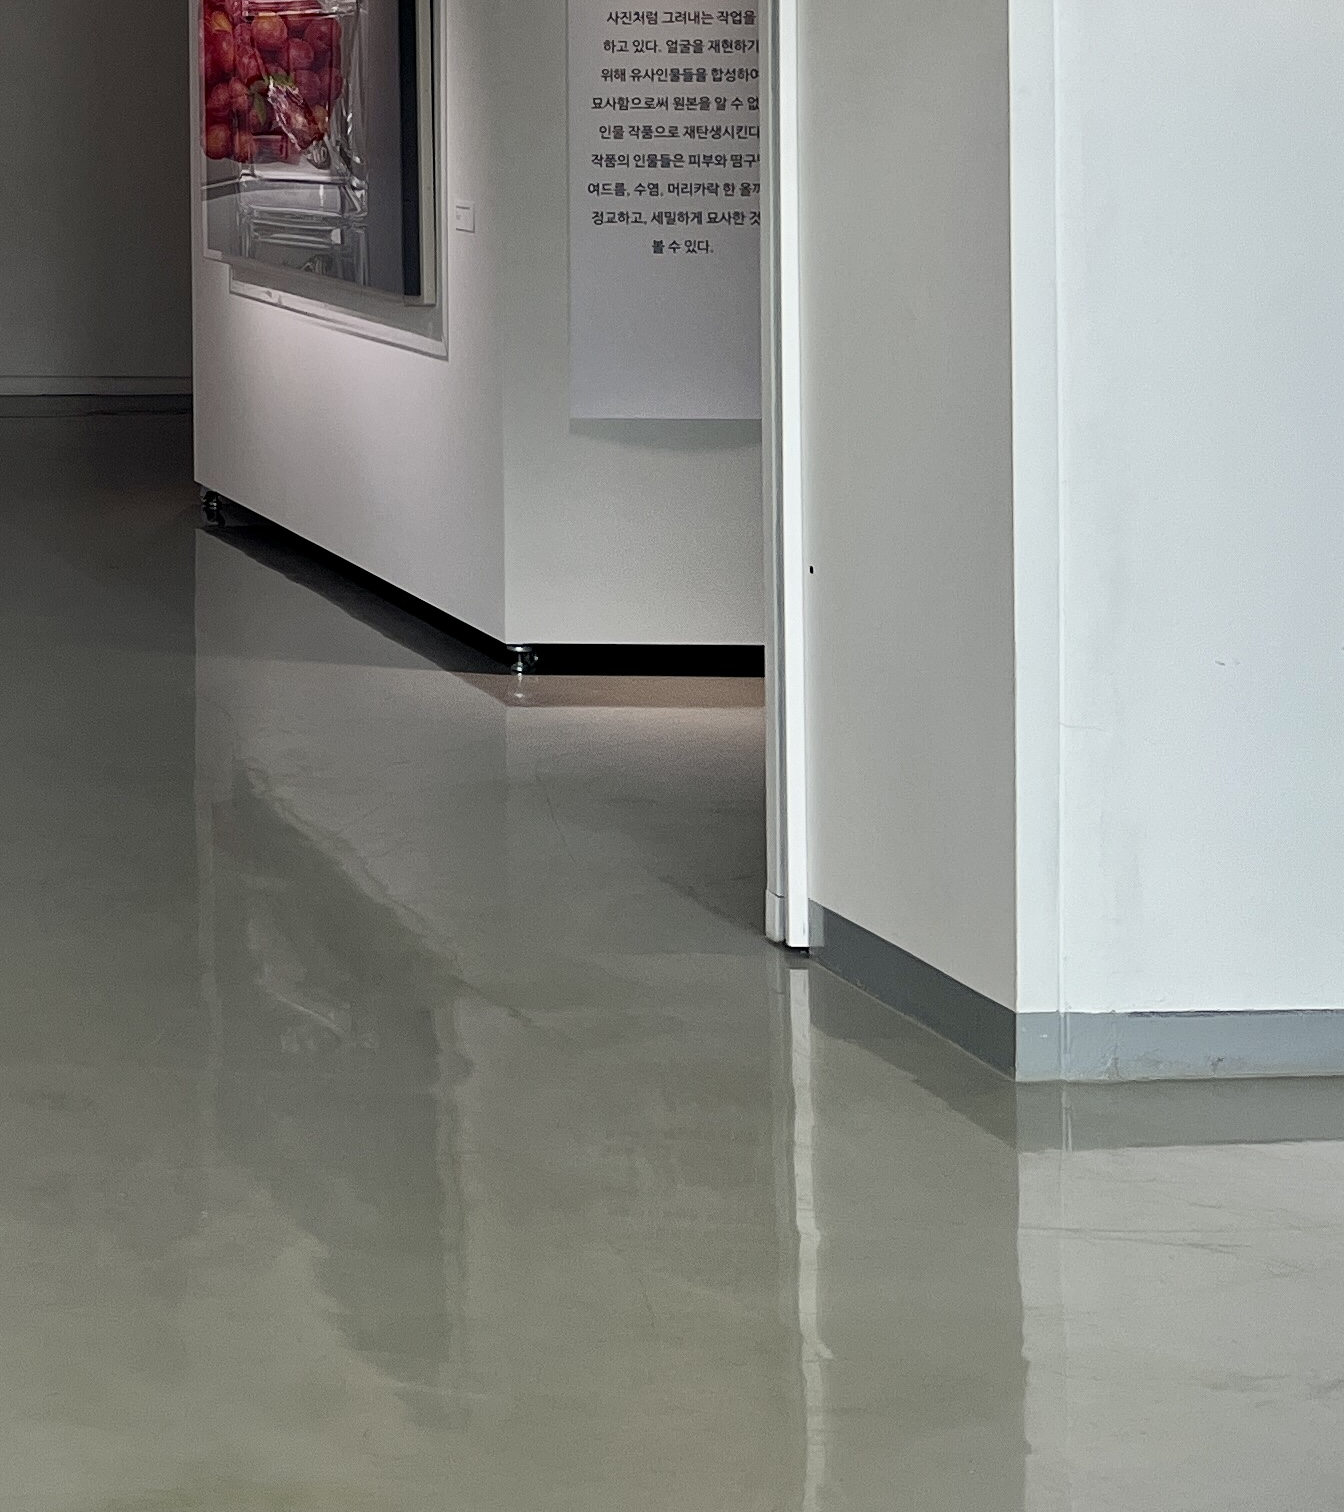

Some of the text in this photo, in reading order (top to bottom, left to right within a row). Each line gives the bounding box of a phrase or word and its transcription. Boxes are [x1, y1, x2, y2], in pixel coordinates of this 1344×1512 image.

[606, 10, 757, 25] 사진처럼 그려내는 작업을
[603, 39, 629, 54] 하고
[666, 39, 705, 54] 얼굴을
[601, 67, 627, 83] 위해
[629, 67, 708, 83] 유사인물들을
[591, 96, 669, 111] 묘사함으로써
[672, 96, 711, 111] 원본을
[730, 96, 744, 111] 수
[599, 125, 624, 139] 인물
[628, 125, 681, 139] 작품으로
[591, 153, 630, 168] 작품의
[633, 153, 685, 168] 인물들은
[688, 153, 728, 168] 피부와
[667, 182, 720, 197] 머리카락
[723, 182, 736, 197] 한
[650, 211, 703, 225] 세밀하게
[706, 211, 746, 225] 묘사한
[668, 239, 681, 254] 수
